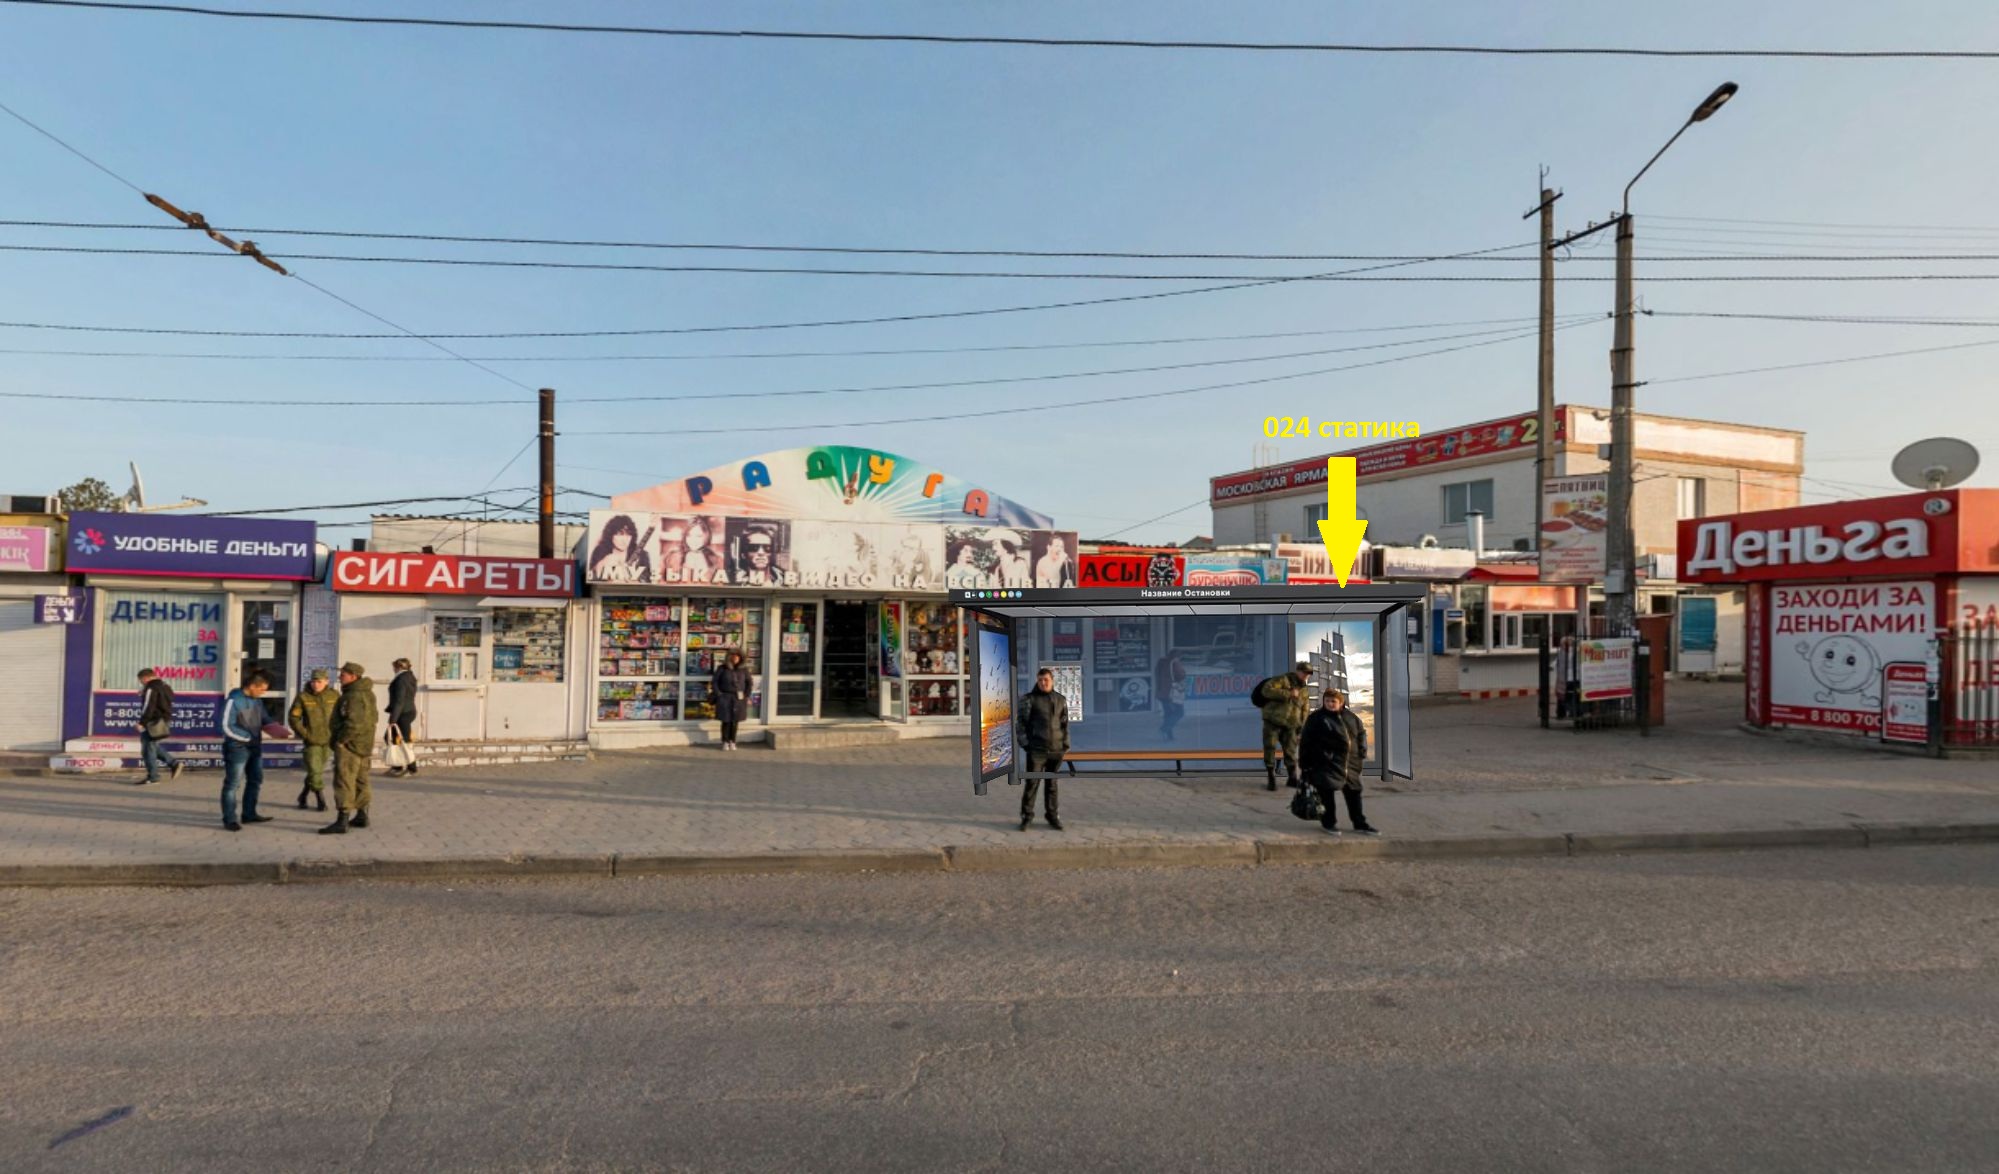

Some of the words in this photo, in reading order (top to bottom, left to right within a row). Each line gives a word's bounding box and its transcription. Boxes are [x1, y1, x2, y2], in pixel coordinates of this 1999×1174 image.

[685, 450, 989, 519] РАДУГА
[1216, 475, 1287, 498] МОСКОВСКАЯ
[1294, 467, 1328, 485] ЯРМА
[1560, 480, 1606, 493] ПЯТНИЦ
[113, 534, 218, 555] УДОБНЫЕ
[225, 539, 308, 558] ДЕНЬГИ
[1686, 517, 1929, 576] Деньга
[337, 556, 572, 592] СИГАРЕТЫ
[602, 565, 730, 584] МУЗЫКА
[783, 571, 877, 588] ВИДЕО
[893, 573, 928, 589] НА
[1082, 561, 1142, 583] АСЫ
[1141, 589, 1182, 597] Название
[1184, 589, 1231, 597] Остановки
[1776, 585, 1880, 610] ЗАХОДИ
[1887, 586, 1926, 607] ЗА
[111, 600, 221, 623] ДЕНЬГИ
[1775, 612, 1926, 636] ДЕНЬГАМИ!
[197, 629, 219, 642] ЗА
[188, 645, 218, 664] 15
[153, 666, 217, 680] МИНУТ
[1810, 710, 1820, 721] 8
[1823, 711, 1852, 724] 800
[89, 742, 124, 751] ДЕНЬГИ
[65, 758, 105, 768] ПРОСТО
